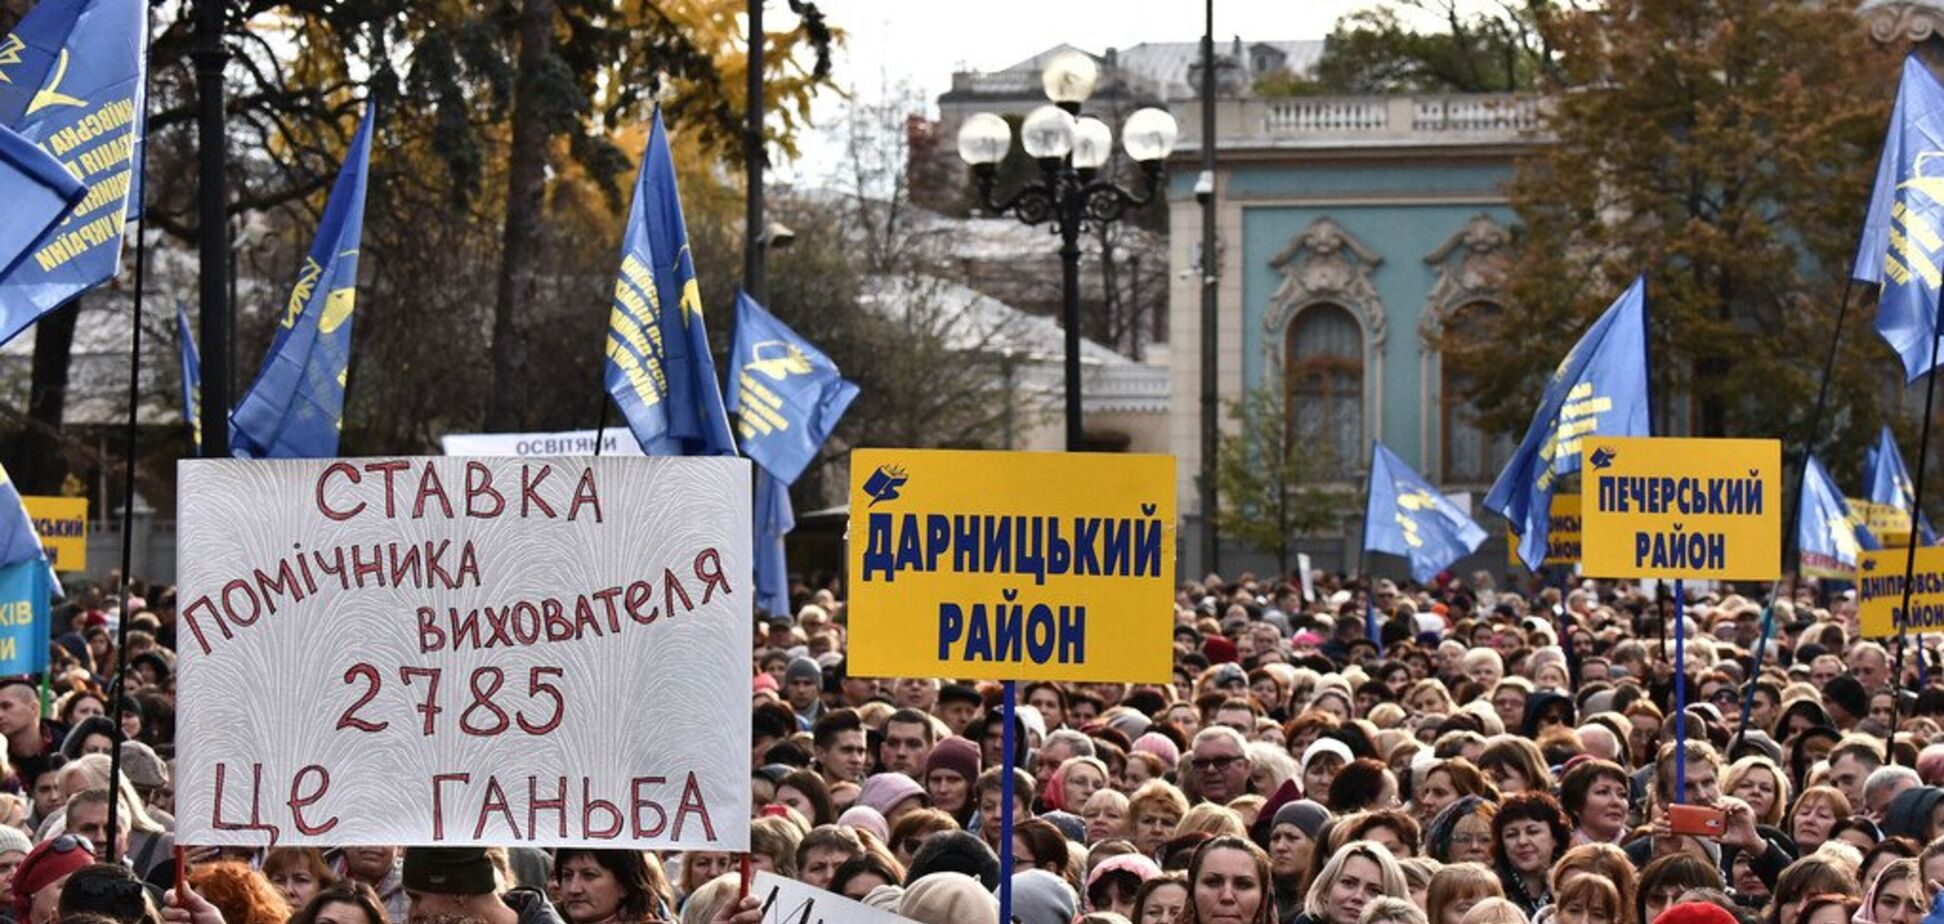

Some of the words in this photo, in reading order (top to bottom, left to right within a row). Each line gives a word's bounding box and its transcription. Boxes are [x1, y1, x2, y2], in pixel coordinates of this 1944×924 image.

[315, 460, 604, 523] СТАВКА
[1598, 469, 1762, 515] ПЕЧЕРСЬКИЙ
[862, 503, 1162, 586] ДАРНИЦЬКИЙ
[1635, 523, 1724, 570] РАЙОН
[938, 588, 1086, 665] РАЙОН
[335, 662, 565, 736] 2785
[432, 770, 718, 842] ГАНЬБА
